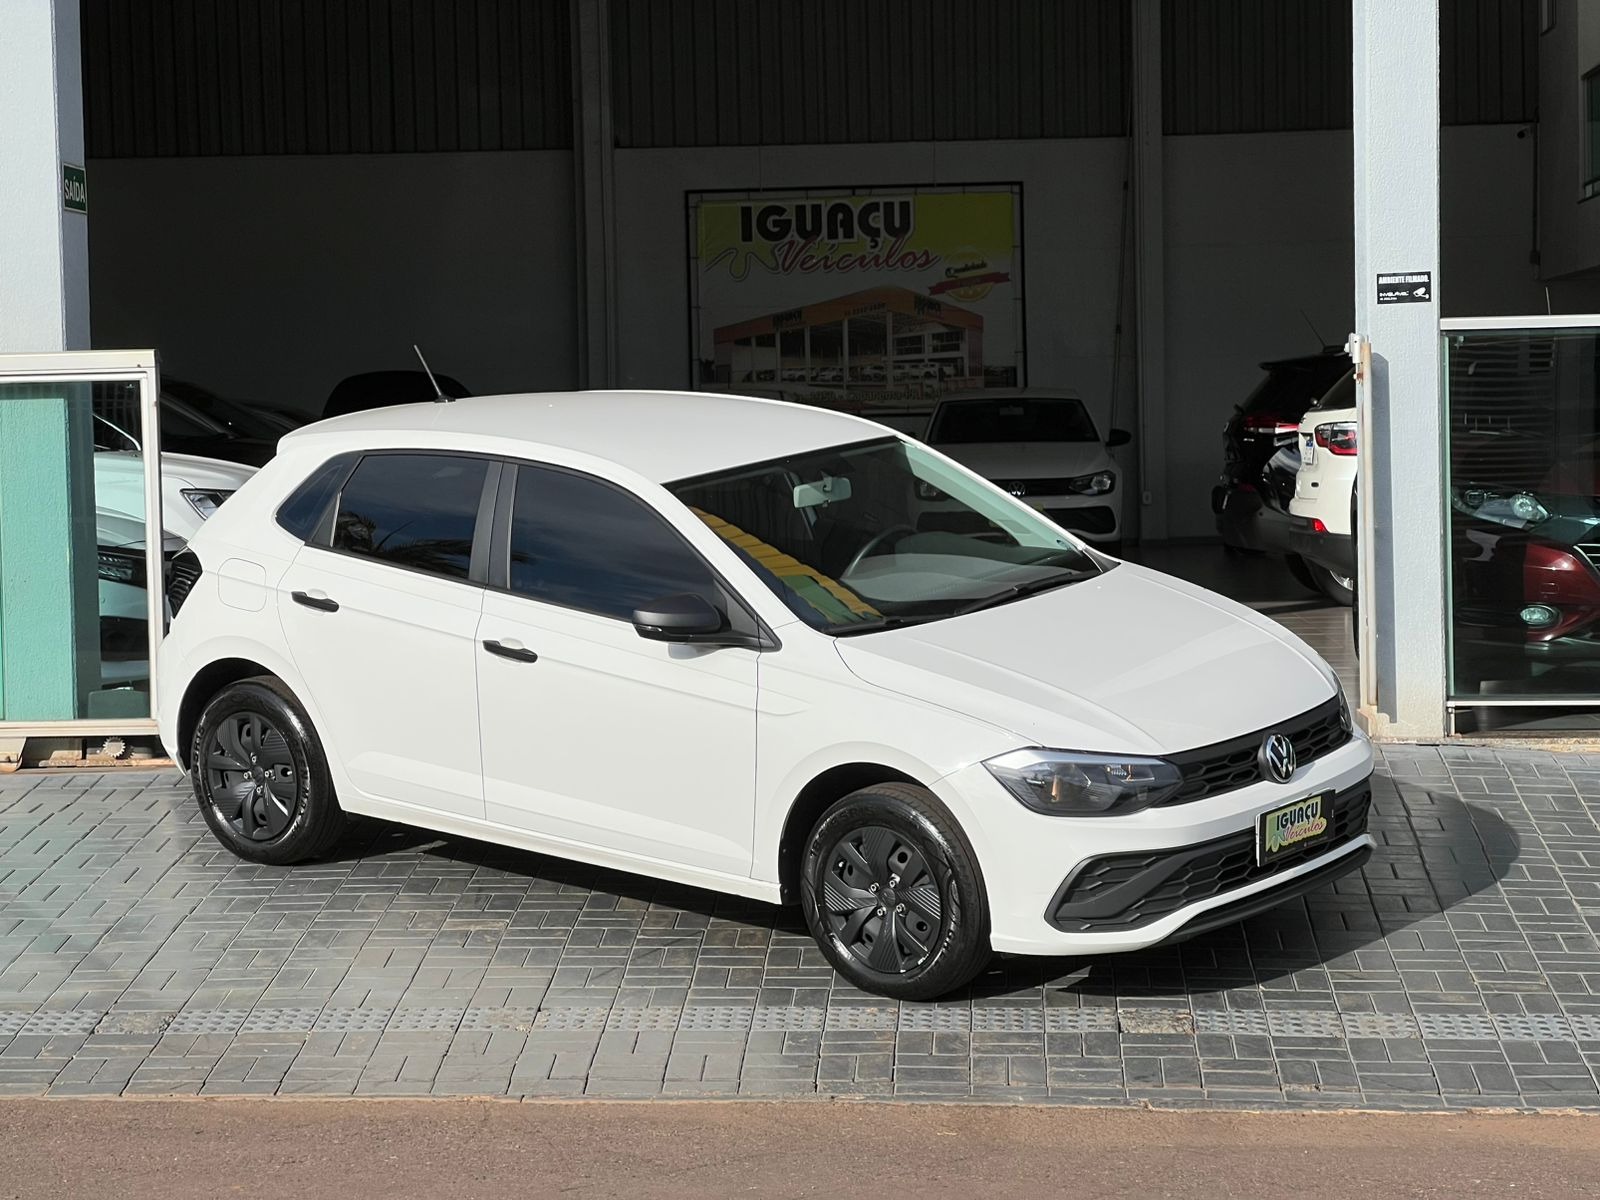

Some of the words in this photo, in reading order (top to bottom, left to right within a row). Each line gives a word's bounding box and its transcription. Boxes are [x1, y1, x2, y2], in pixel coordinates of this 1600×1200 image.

[64, 176, 86, 203] SAÍDA
[741, 200, 911, 249] IGUAÇU
[777, 238, 941, 274] Veículos
[1276, 801, 1319, 831] IGUAÇU
[1285, 820, 1324, 841] Veículos
